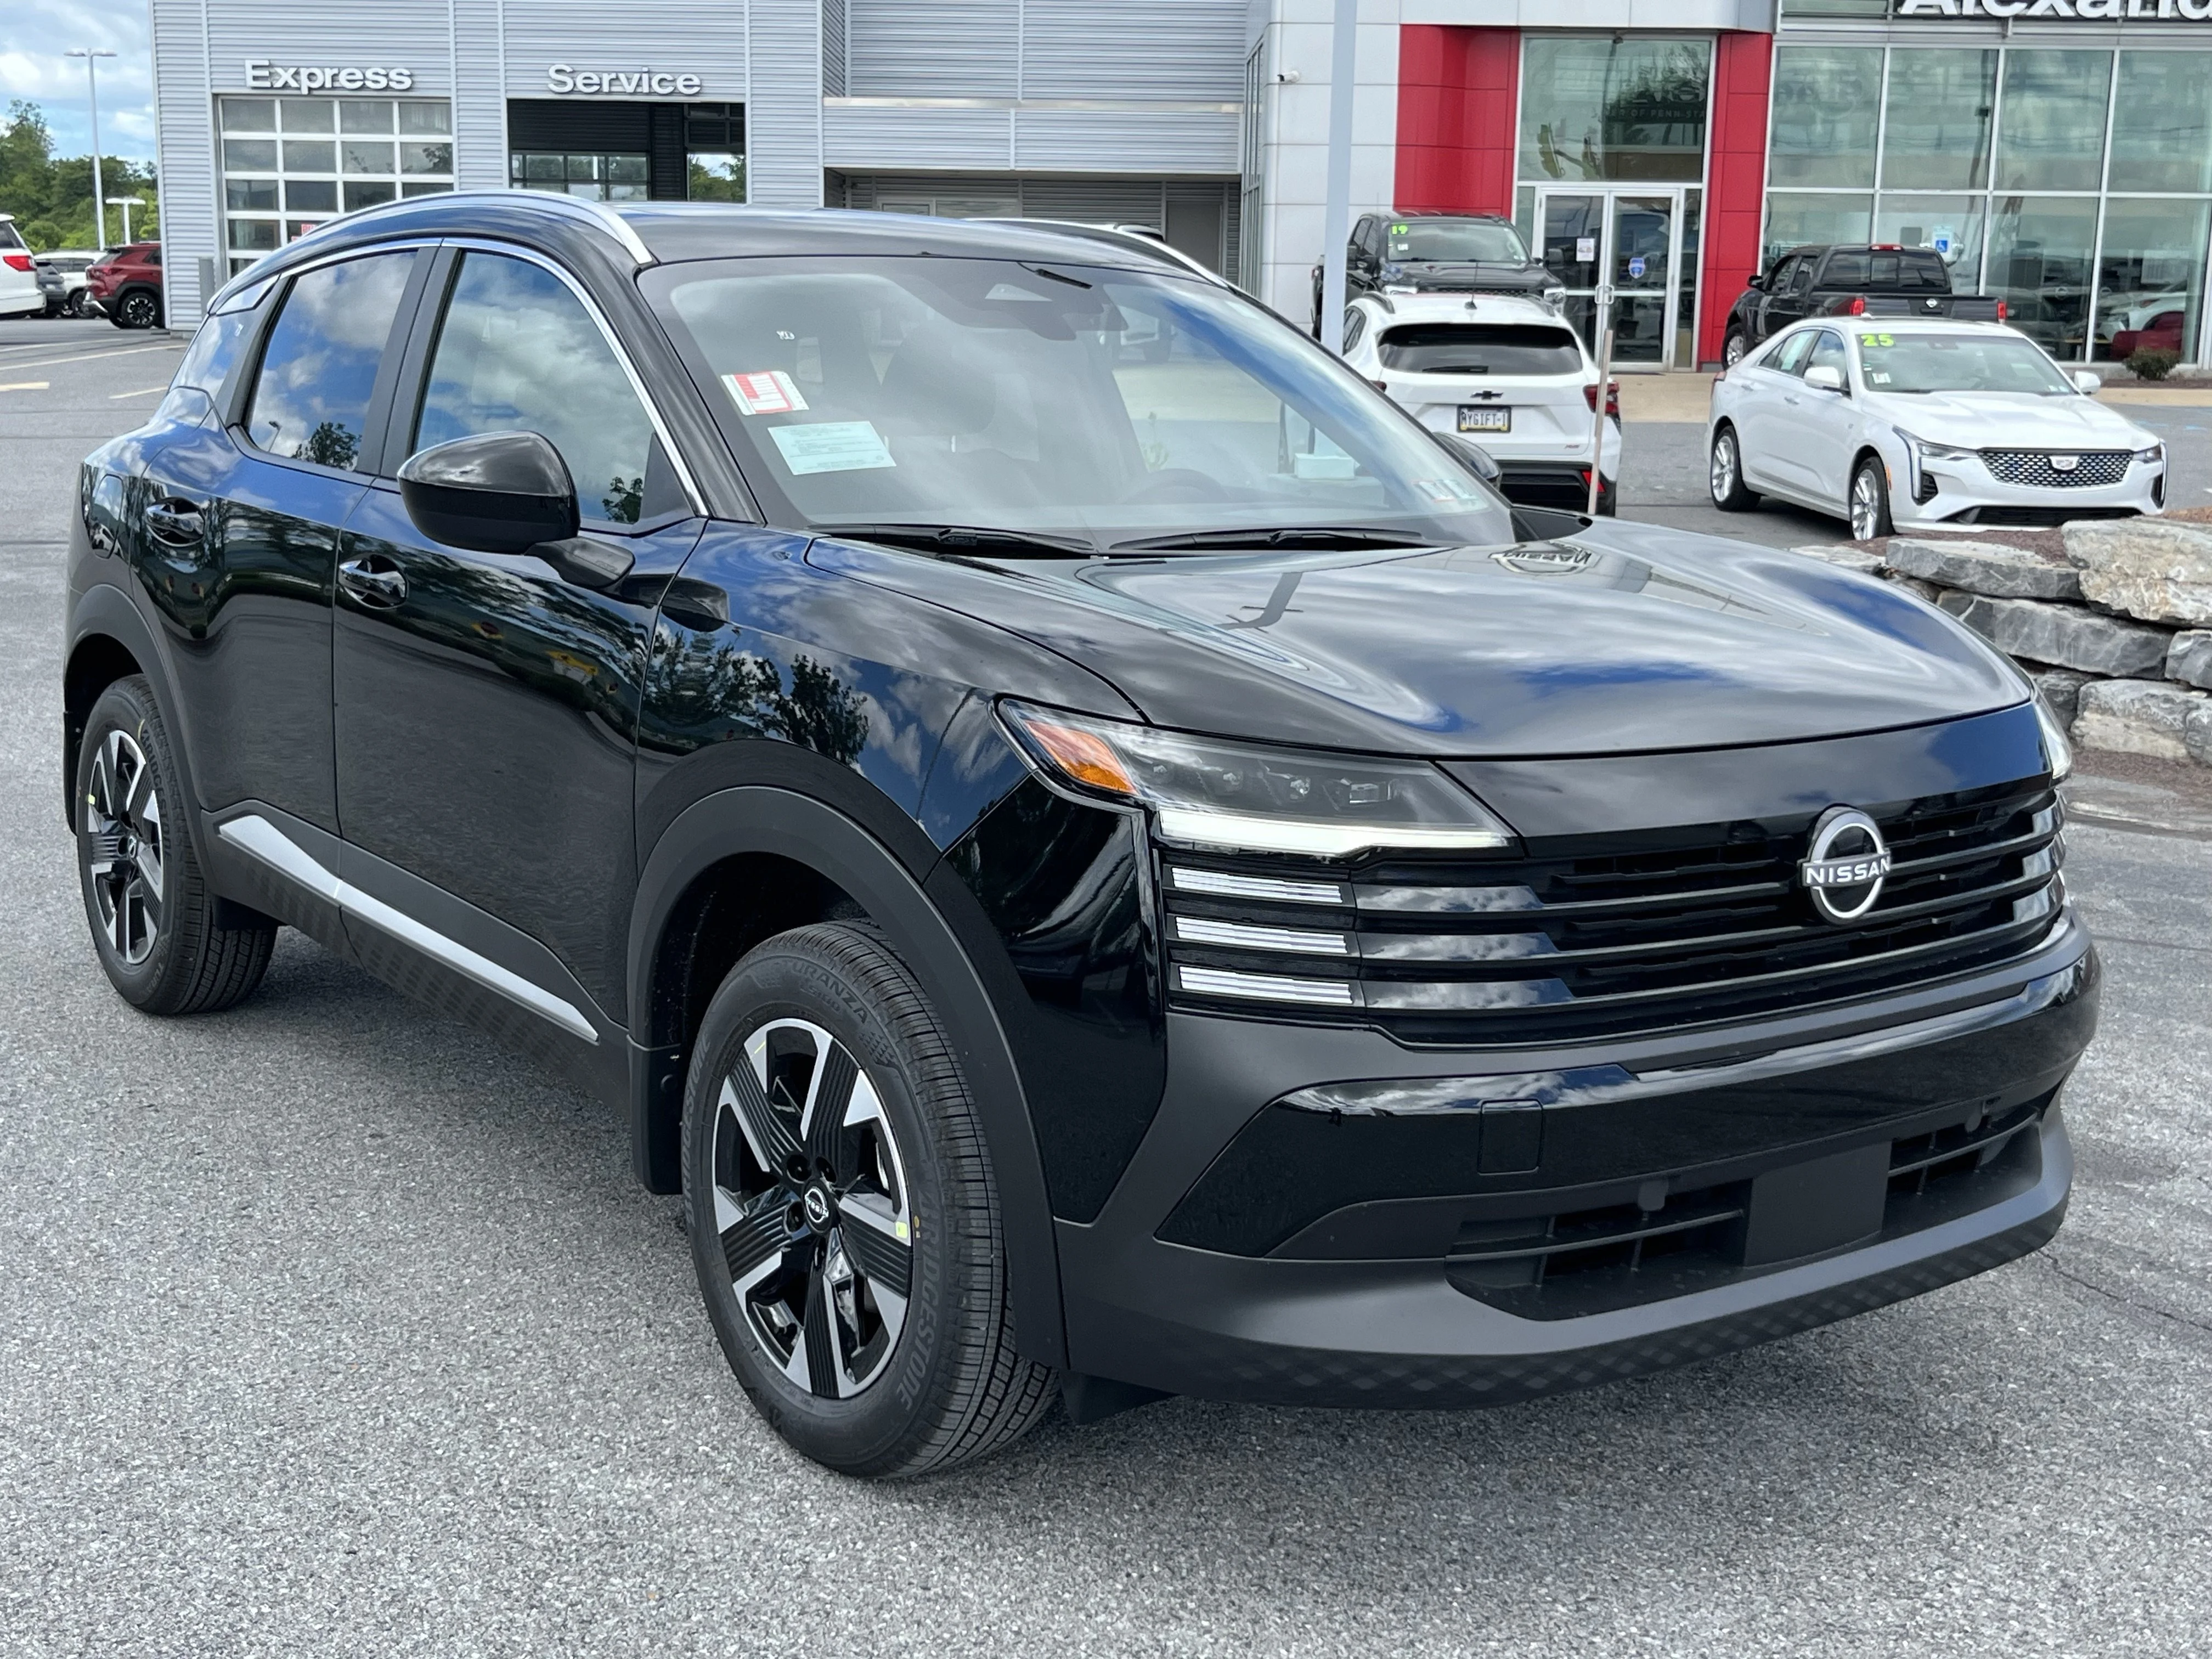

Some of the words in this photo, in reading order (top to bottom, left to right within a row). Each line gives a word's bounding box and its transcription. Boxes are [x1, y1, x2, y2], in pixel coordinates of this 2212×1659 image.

[245, 59, 412, 95] Express
[548, 64, 702, 95] Service
[1392, 225, 1408, 235] 19
[1860, 335, 1894, 347] 25
[1806, 856, 1891, 884] NISSAN
[896, 1190, 941, 1412] BRIDGESTONE
